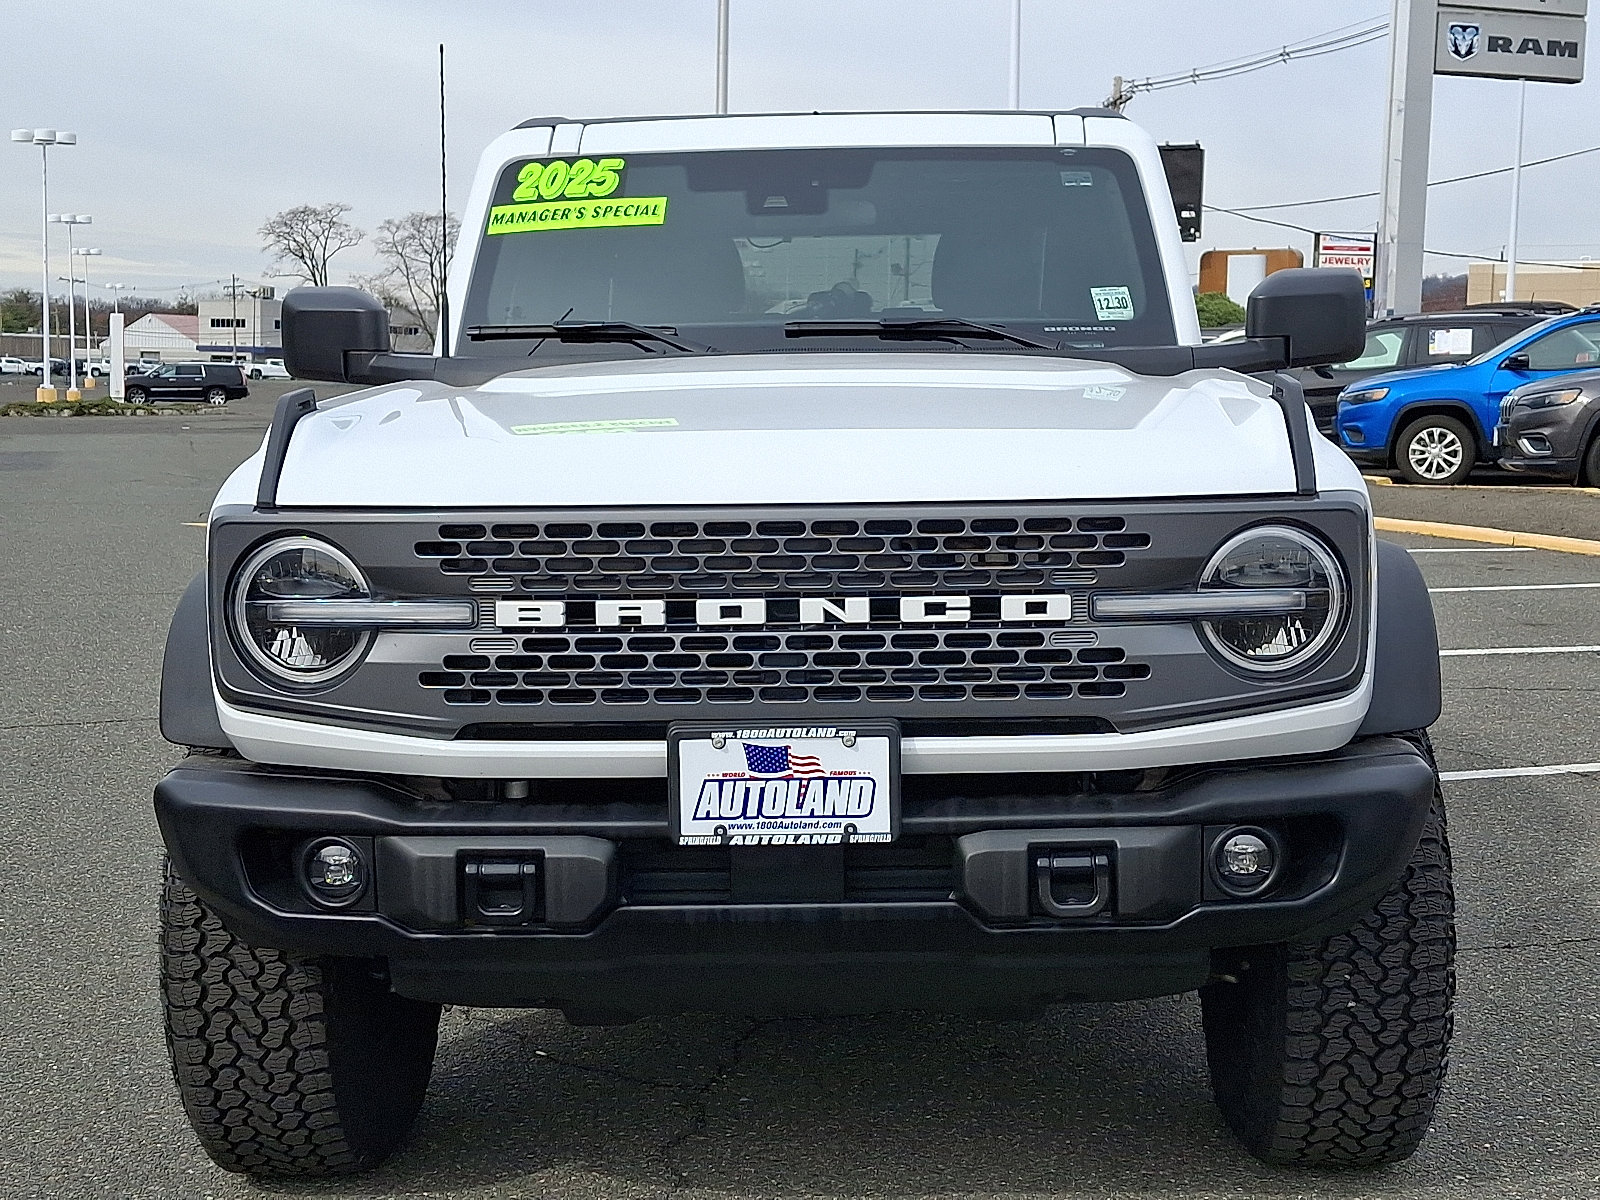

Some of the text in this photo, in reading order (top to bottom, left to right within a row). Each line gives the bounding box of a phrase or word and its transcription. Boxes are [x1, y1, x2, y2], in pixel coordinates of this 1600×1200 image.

[1487, 35, 1578, 59] RAM
[512, 157, 625, 202] 2025
[491, 203, 660, 226] MANAGER'S SPECIAL
[1321, 256, 1371, 266] JEWELRY
[495, 593, 1072, 627] BRONCO
[711, 727, 857, 739] www.1800AUTOLAND.com
[694, 778, 875, 820] AUTOLAND
[728, 820, 842, 831] www.1800Autoland.com
[679, 833, 892, 846] SPRINGFIELD AUTOLAND SPRINGFIELD
